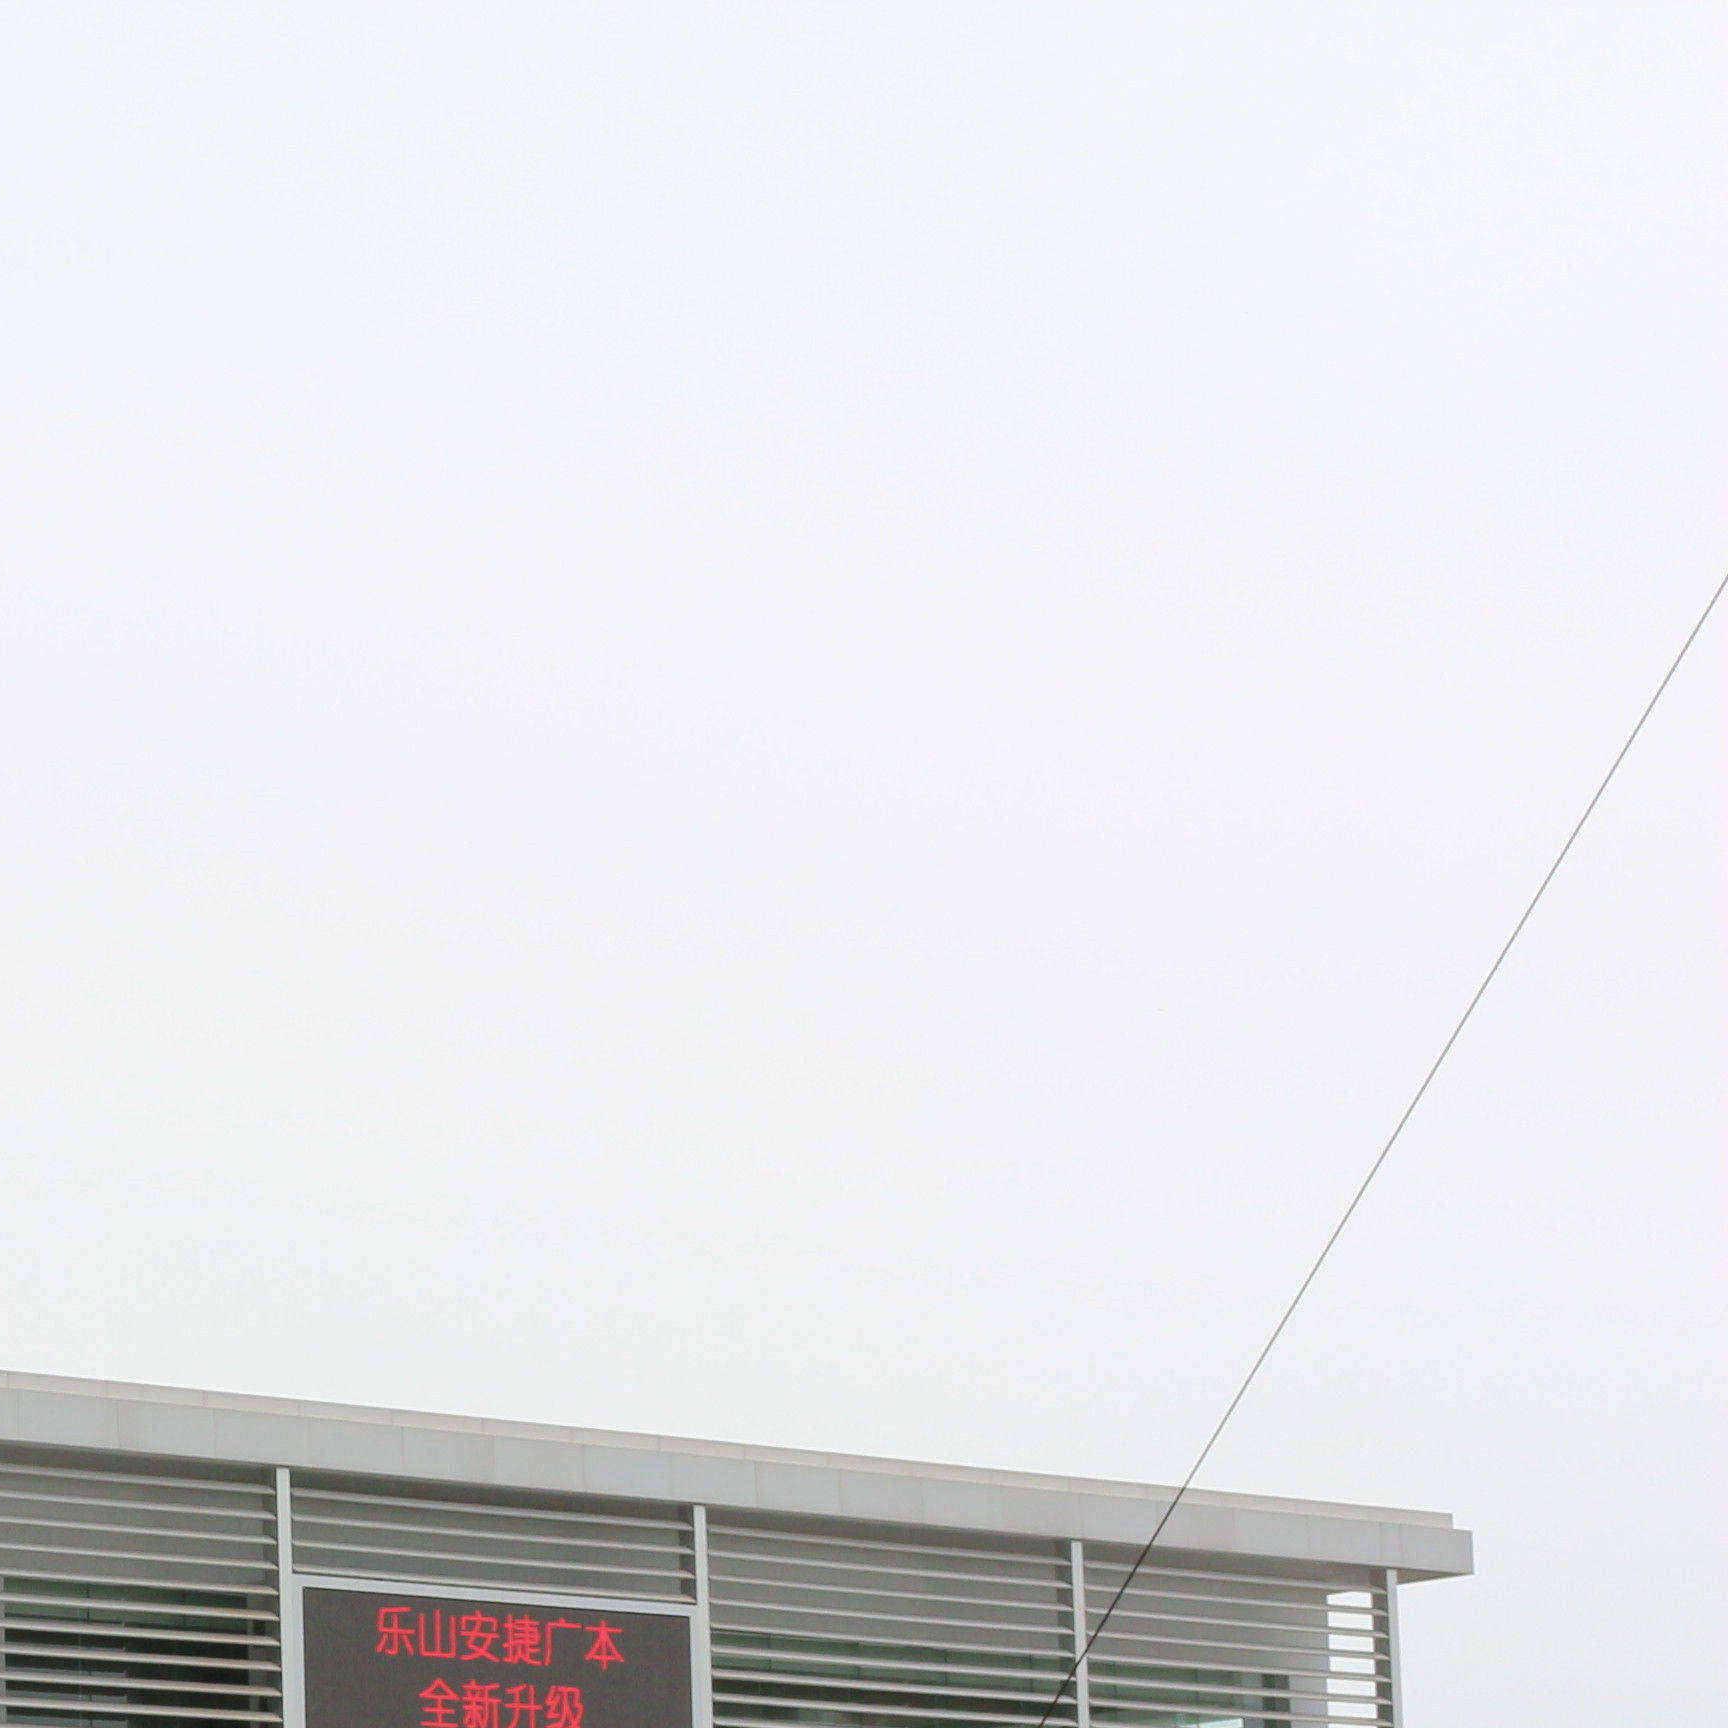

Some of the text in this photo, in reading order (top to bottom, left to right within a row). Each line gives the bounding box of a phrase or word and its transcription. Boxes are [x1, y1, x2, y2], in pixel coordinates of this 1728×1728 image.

[375, 1606, 625, 1671] 乐山安捷广本
